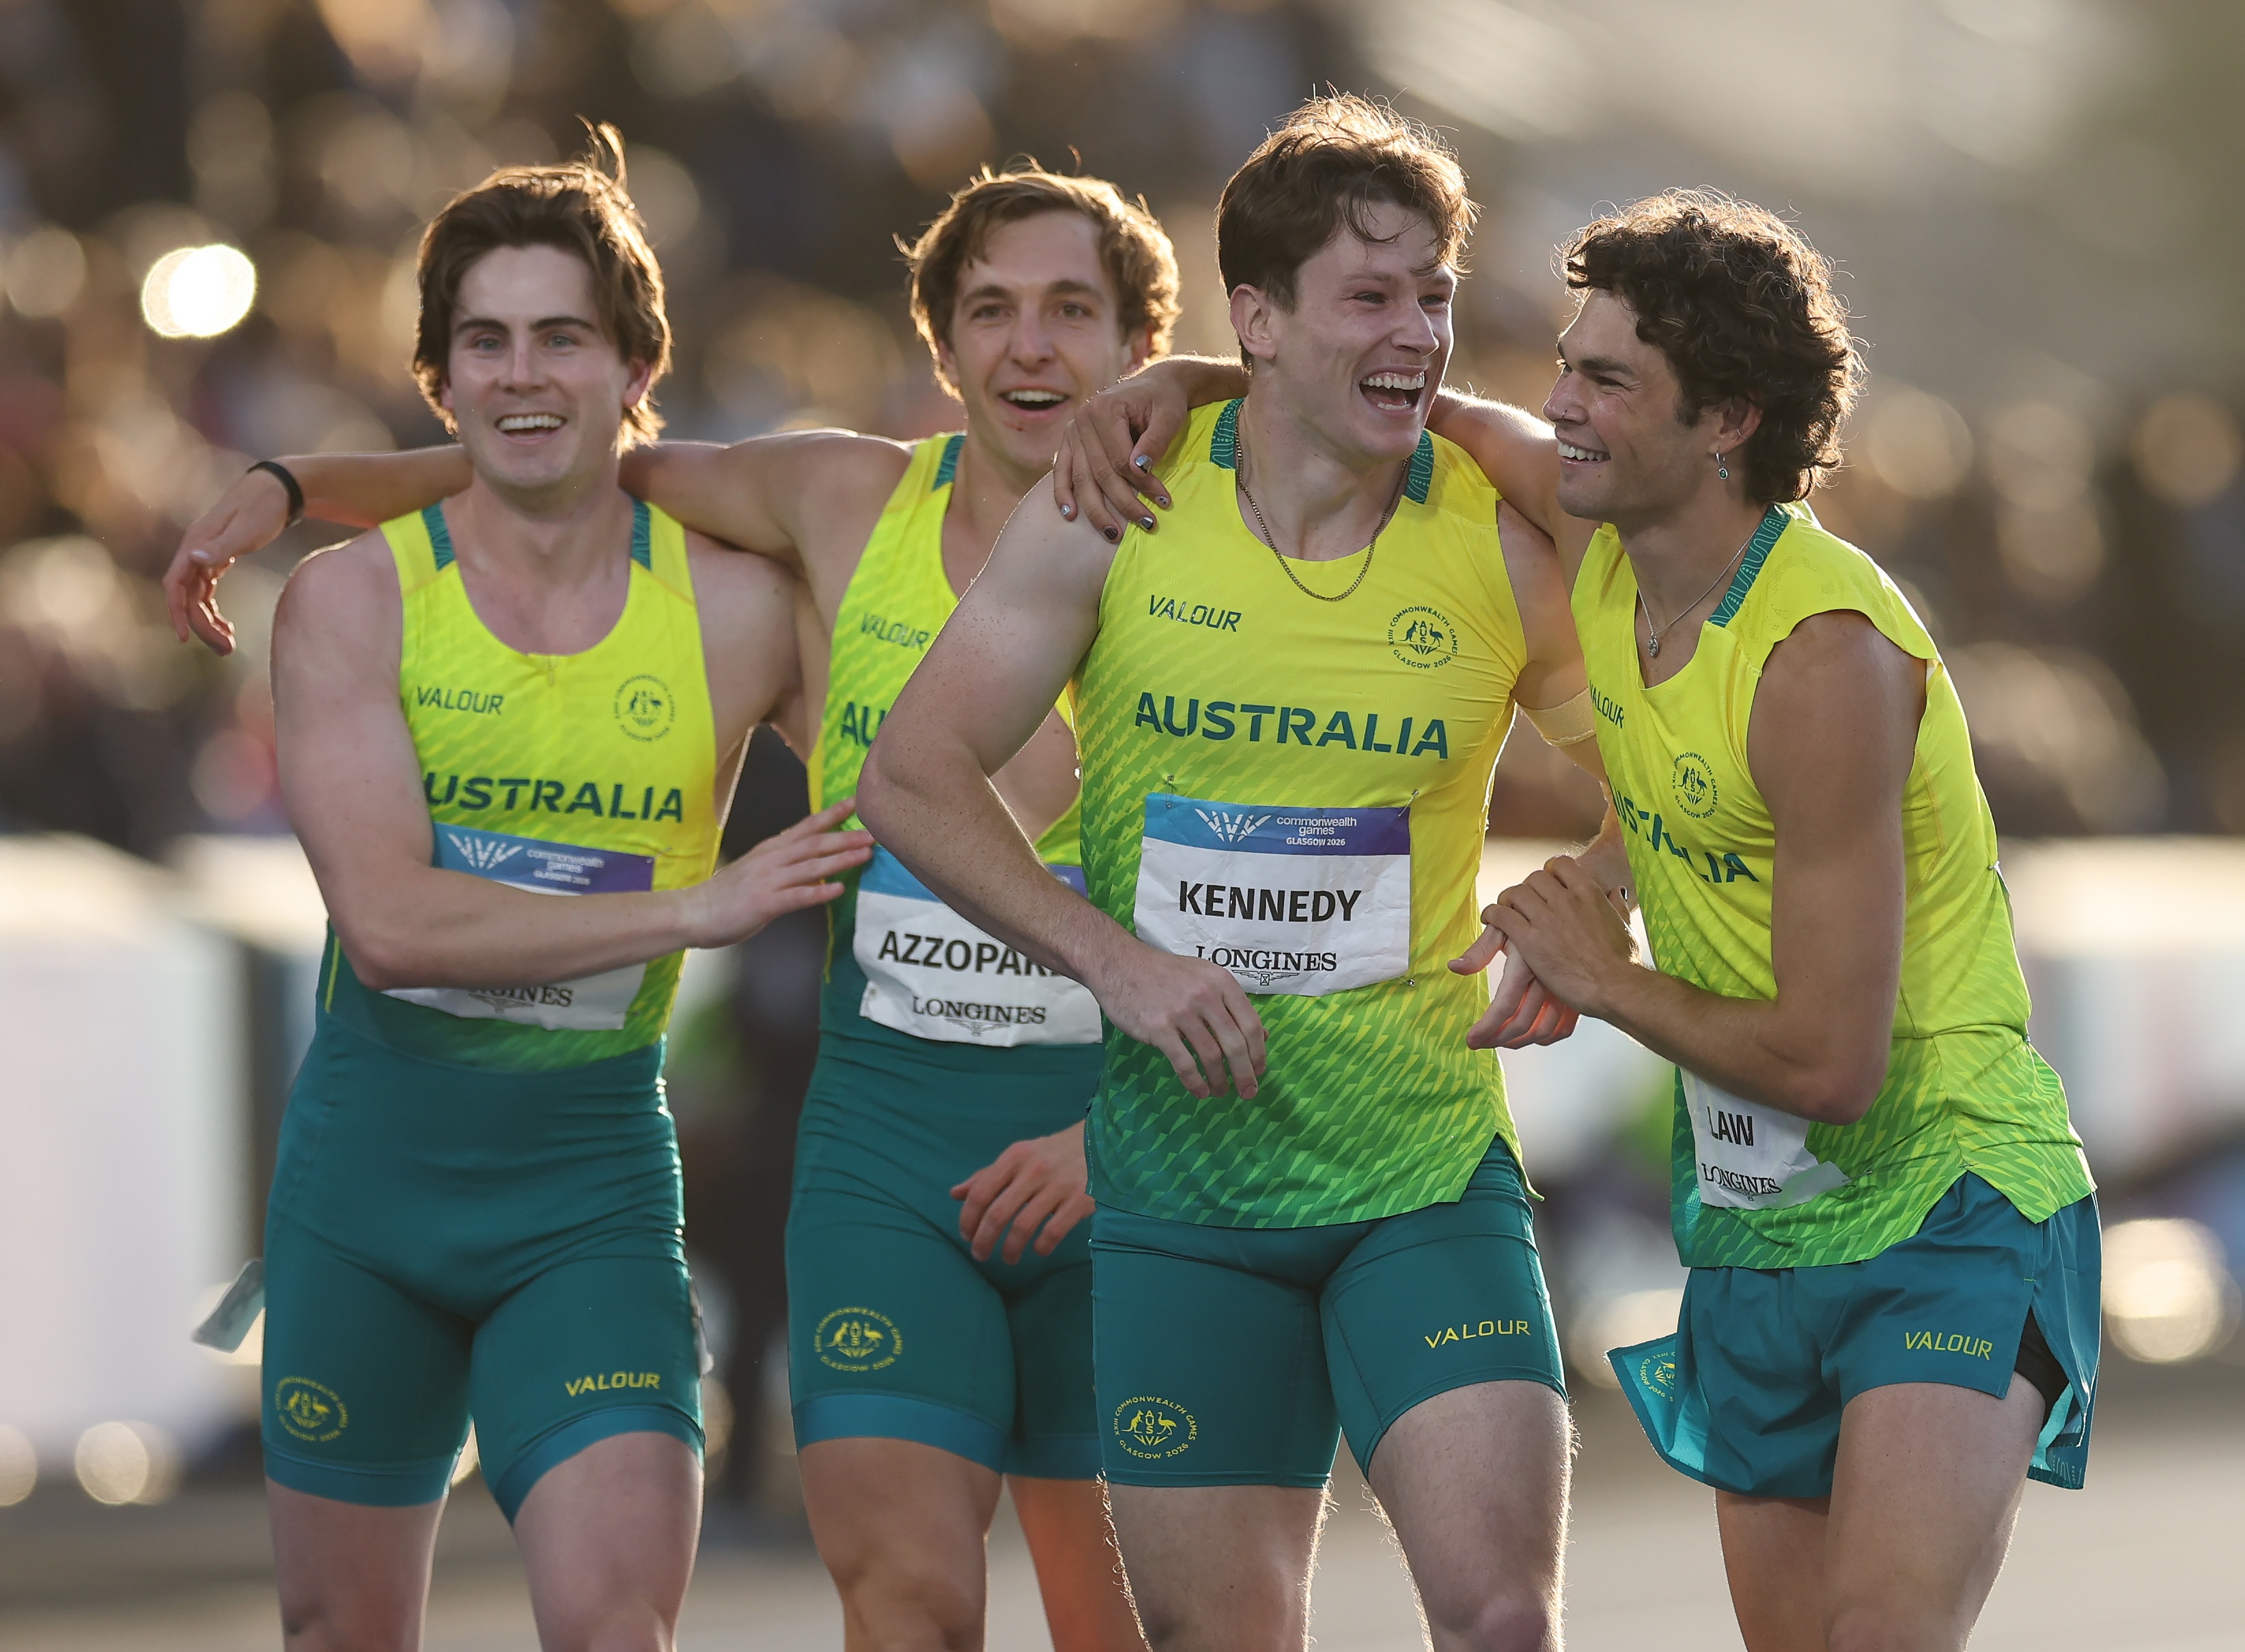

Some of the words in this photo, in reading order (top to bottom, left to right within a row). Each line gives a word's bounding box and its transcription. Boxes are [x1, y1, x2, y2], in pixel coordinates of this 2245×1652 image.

[1149, 595, 1242, 632] VALOUR
[861, 613, 930, 651] VALOUR
[1390, 606, 1450, 627] COMMONWEALTH
[1449, 628, 1458, 655] GAMES
[1419, 620, 1427, 644] AUS
[1393, 649, 1431, 669] GLASGOW
[1434, 655, 1451, 668] 2026
[417, 686, 504, 715] VALOUR
[1589, 679, 1624, 729] VALOUR
[1135, 692, 1449, 759] AUSTRALIA
[424, 772, 683, 824] USTRALIA
[1675, 795, 1701, 819] GLASGOW
[1701, 807, 1716, 819] 2026
[1277, 817, 1357, 827] commonwealth
[1299, 826, 1335, 837] games
[1286, 837, 1326, 846] GLASGOW
[1180, 880, 1362, 922] KENNEDY
[1196, 946, 1337, 972] LONGINES
[912, 996, 1046, 1024] LONGINES
[1707, 1106, 1754, 1147] LAW
[1701, 1163, 1782, 1194] LONGINES
[1424, 1320, 1531, 1349] VALOUR
[1905, 1331, 1993, 1361] VALOUR
[565, 1371, 660, 1397] VALOUR
[1115, 1395, 1187, 1416] COMMONWEALTH
[1186, 1414, 1197, 1441] GAMES
[1145, 1410, 1154, 1434] AUS
[1119, 1440, 1162, 1459] GLASGOW
[1165, 1442, 1189, 1457] 2026
